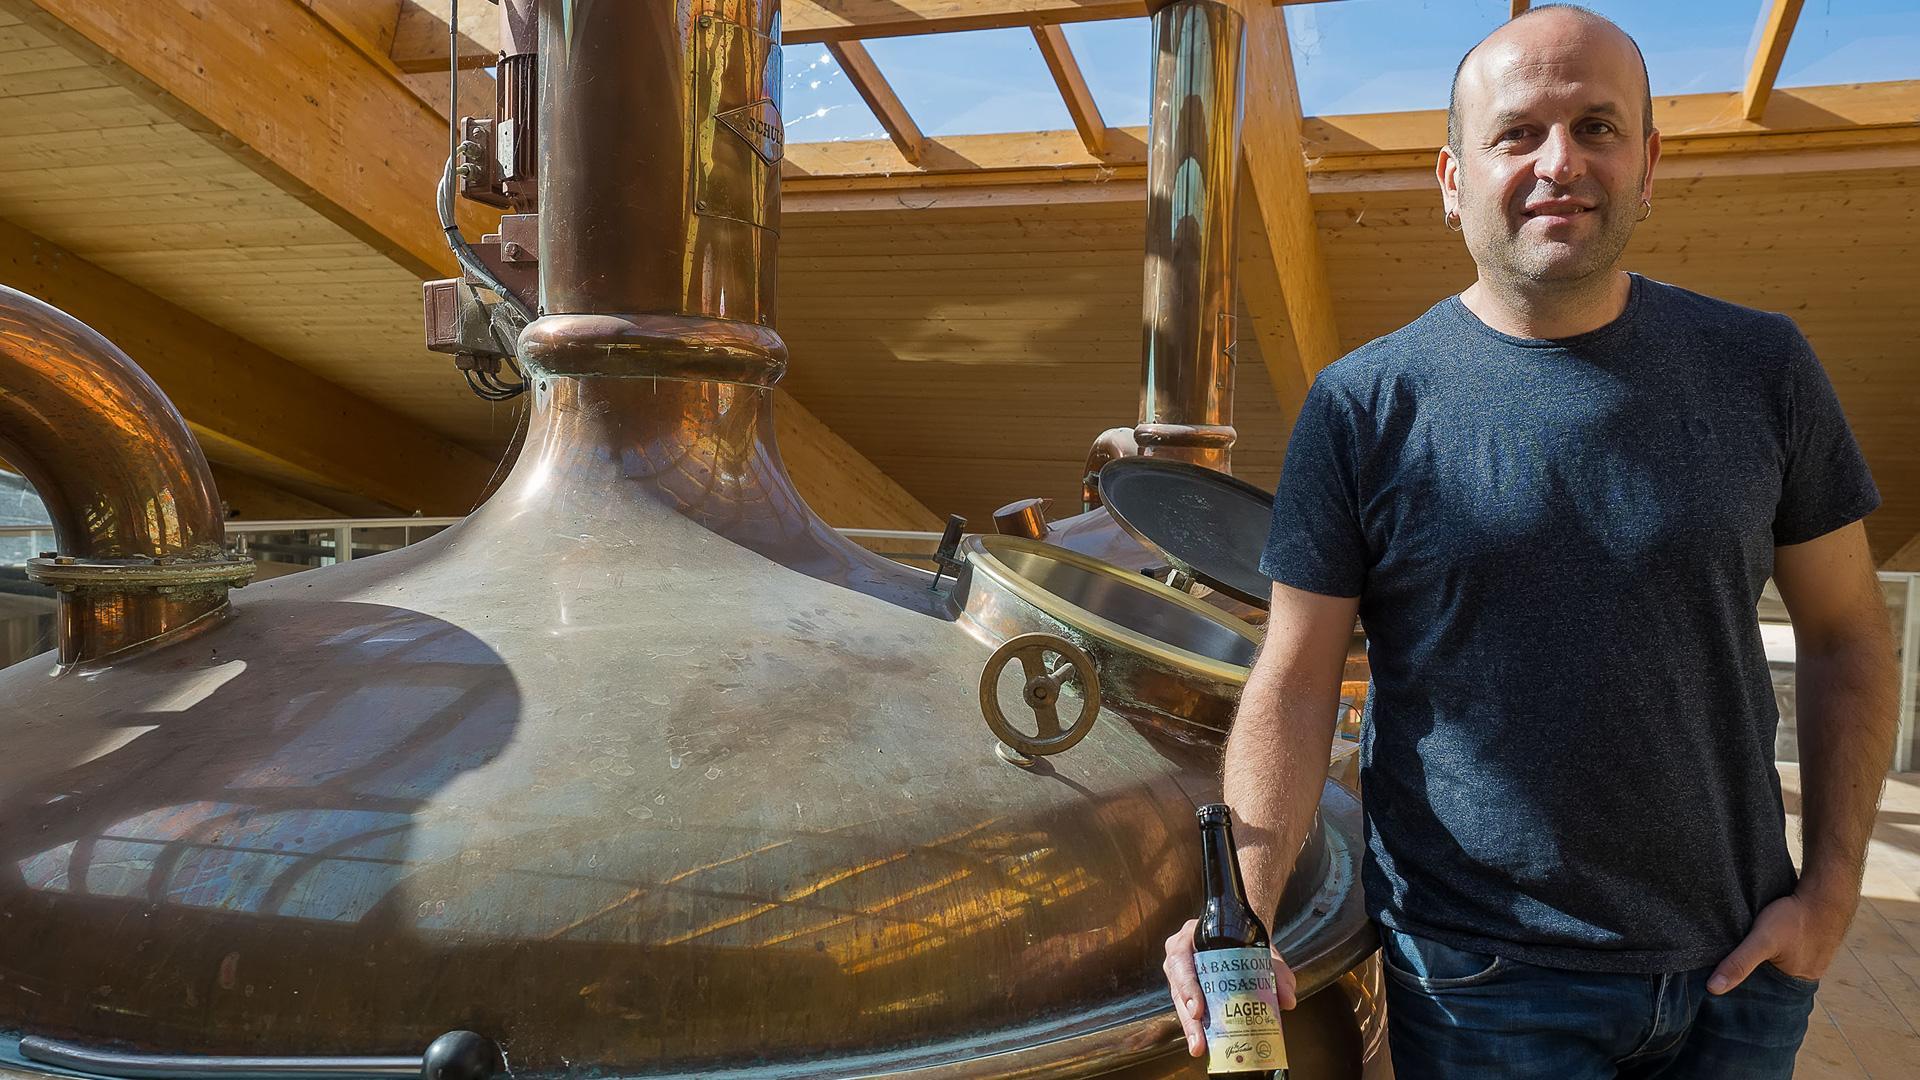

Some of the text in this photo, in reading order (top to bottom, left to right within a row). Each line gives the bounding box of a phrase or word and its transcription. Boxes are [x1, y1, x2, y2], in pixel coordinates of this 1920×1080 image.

[1204, 981, 1215, 993] BI
[1225, 1002, 1268, 1017] LAGER
[1245, 1015, 1263, 1025] BIO
